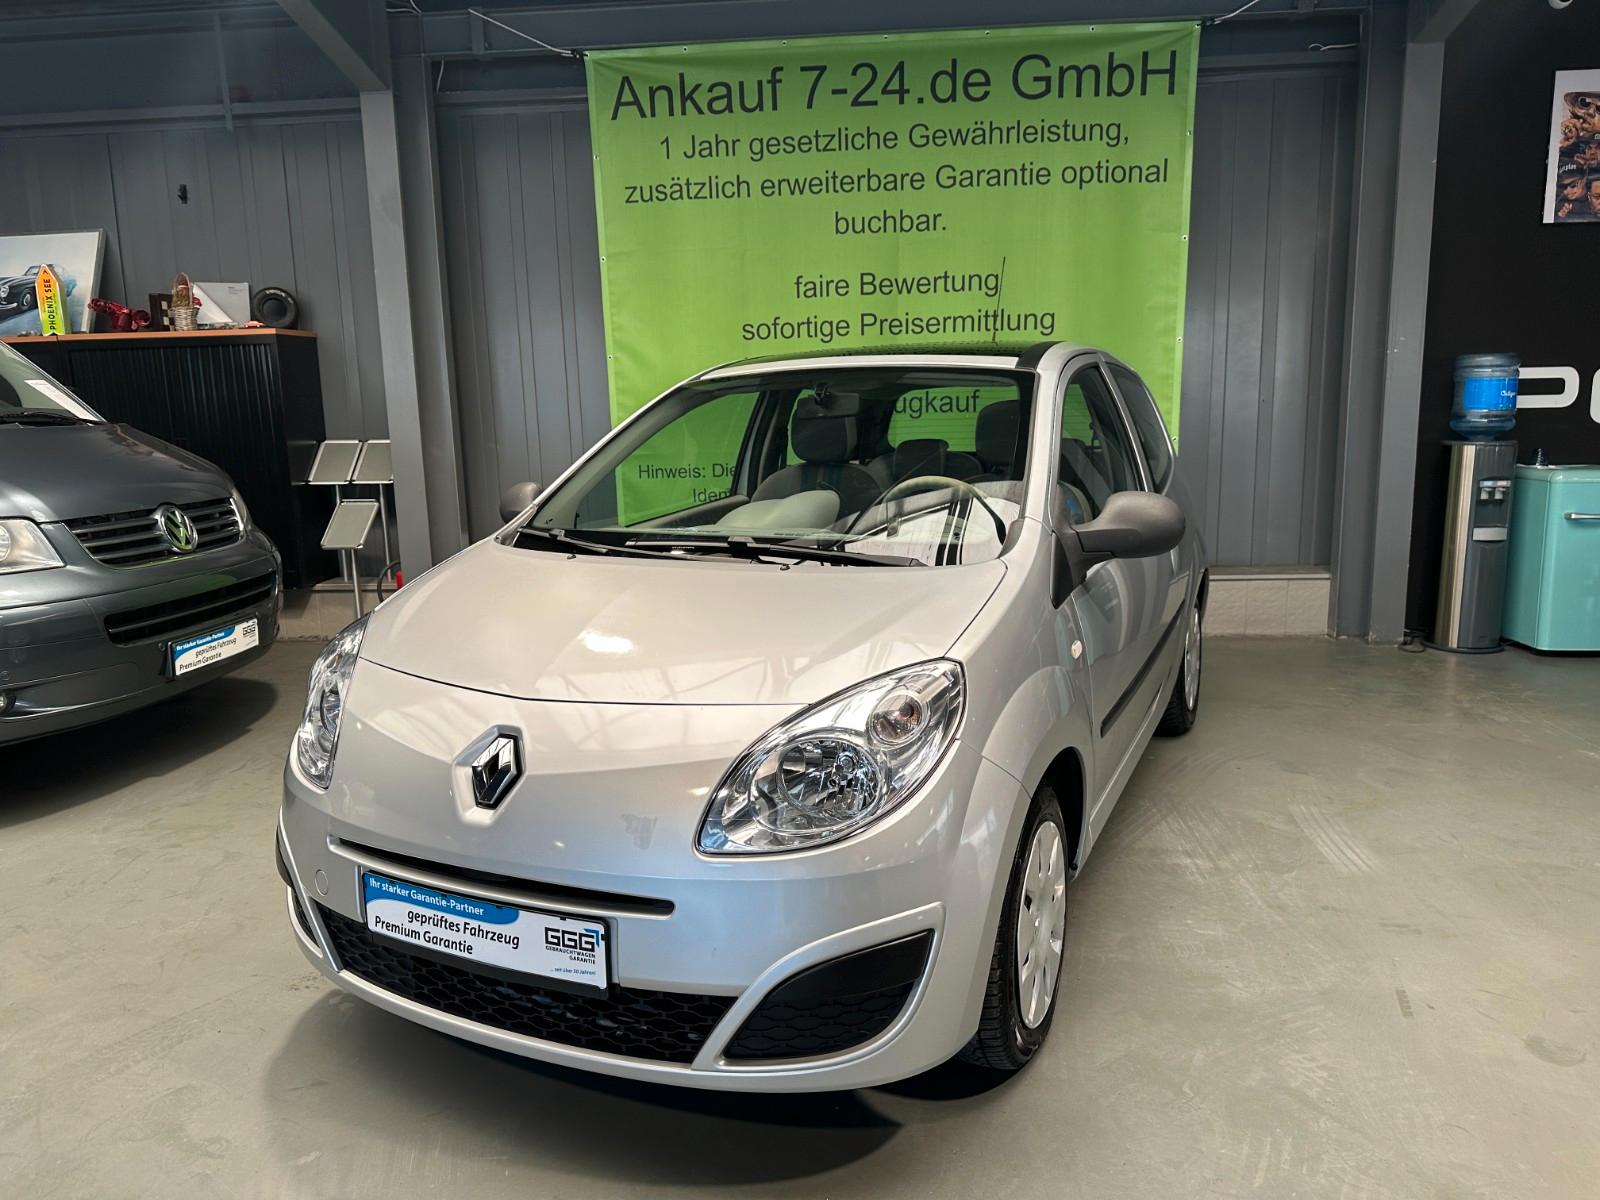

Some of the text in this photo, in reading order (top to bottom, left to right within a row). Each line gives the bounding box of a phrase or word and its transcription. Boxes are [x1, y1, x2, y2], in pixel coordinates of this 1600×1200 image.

[611, 50, 1177, 120] Ankauf 7-24.de GmbH
[660, 119, 1129, 162] 1 Jahr gesetzliche Gewährleistung,
[625, 158, 1169, 204] zusätzlich erweiterbare Garantie optional
[835, 209, 947, 235] buchbar.
[43, 279, 52, 293] SEE
[794, 270, 999, 299] faire Bewertung
[46, 295, 56, 330] PHOENIX
[742, 309, 1056, 343] sofortige Preisermittlung
[894, 389, 981, 419] ugkauf
[638, 463, 706, 479] Hinweis:
[179, 652, 222, 671] Premium Garantie
[370, 877, 485, 916] Ihr starker Garantie-Partner
[375, 915, 473, 955] Premium Garantie
[407, 910, 520, 949] geprüftes Fahrzeug
[544, 926, 595, 952] GGG
[545, 945, 596, 959] GEBRAUCHTWAGEN
[569, 955, 596, 965] GARANTIE
